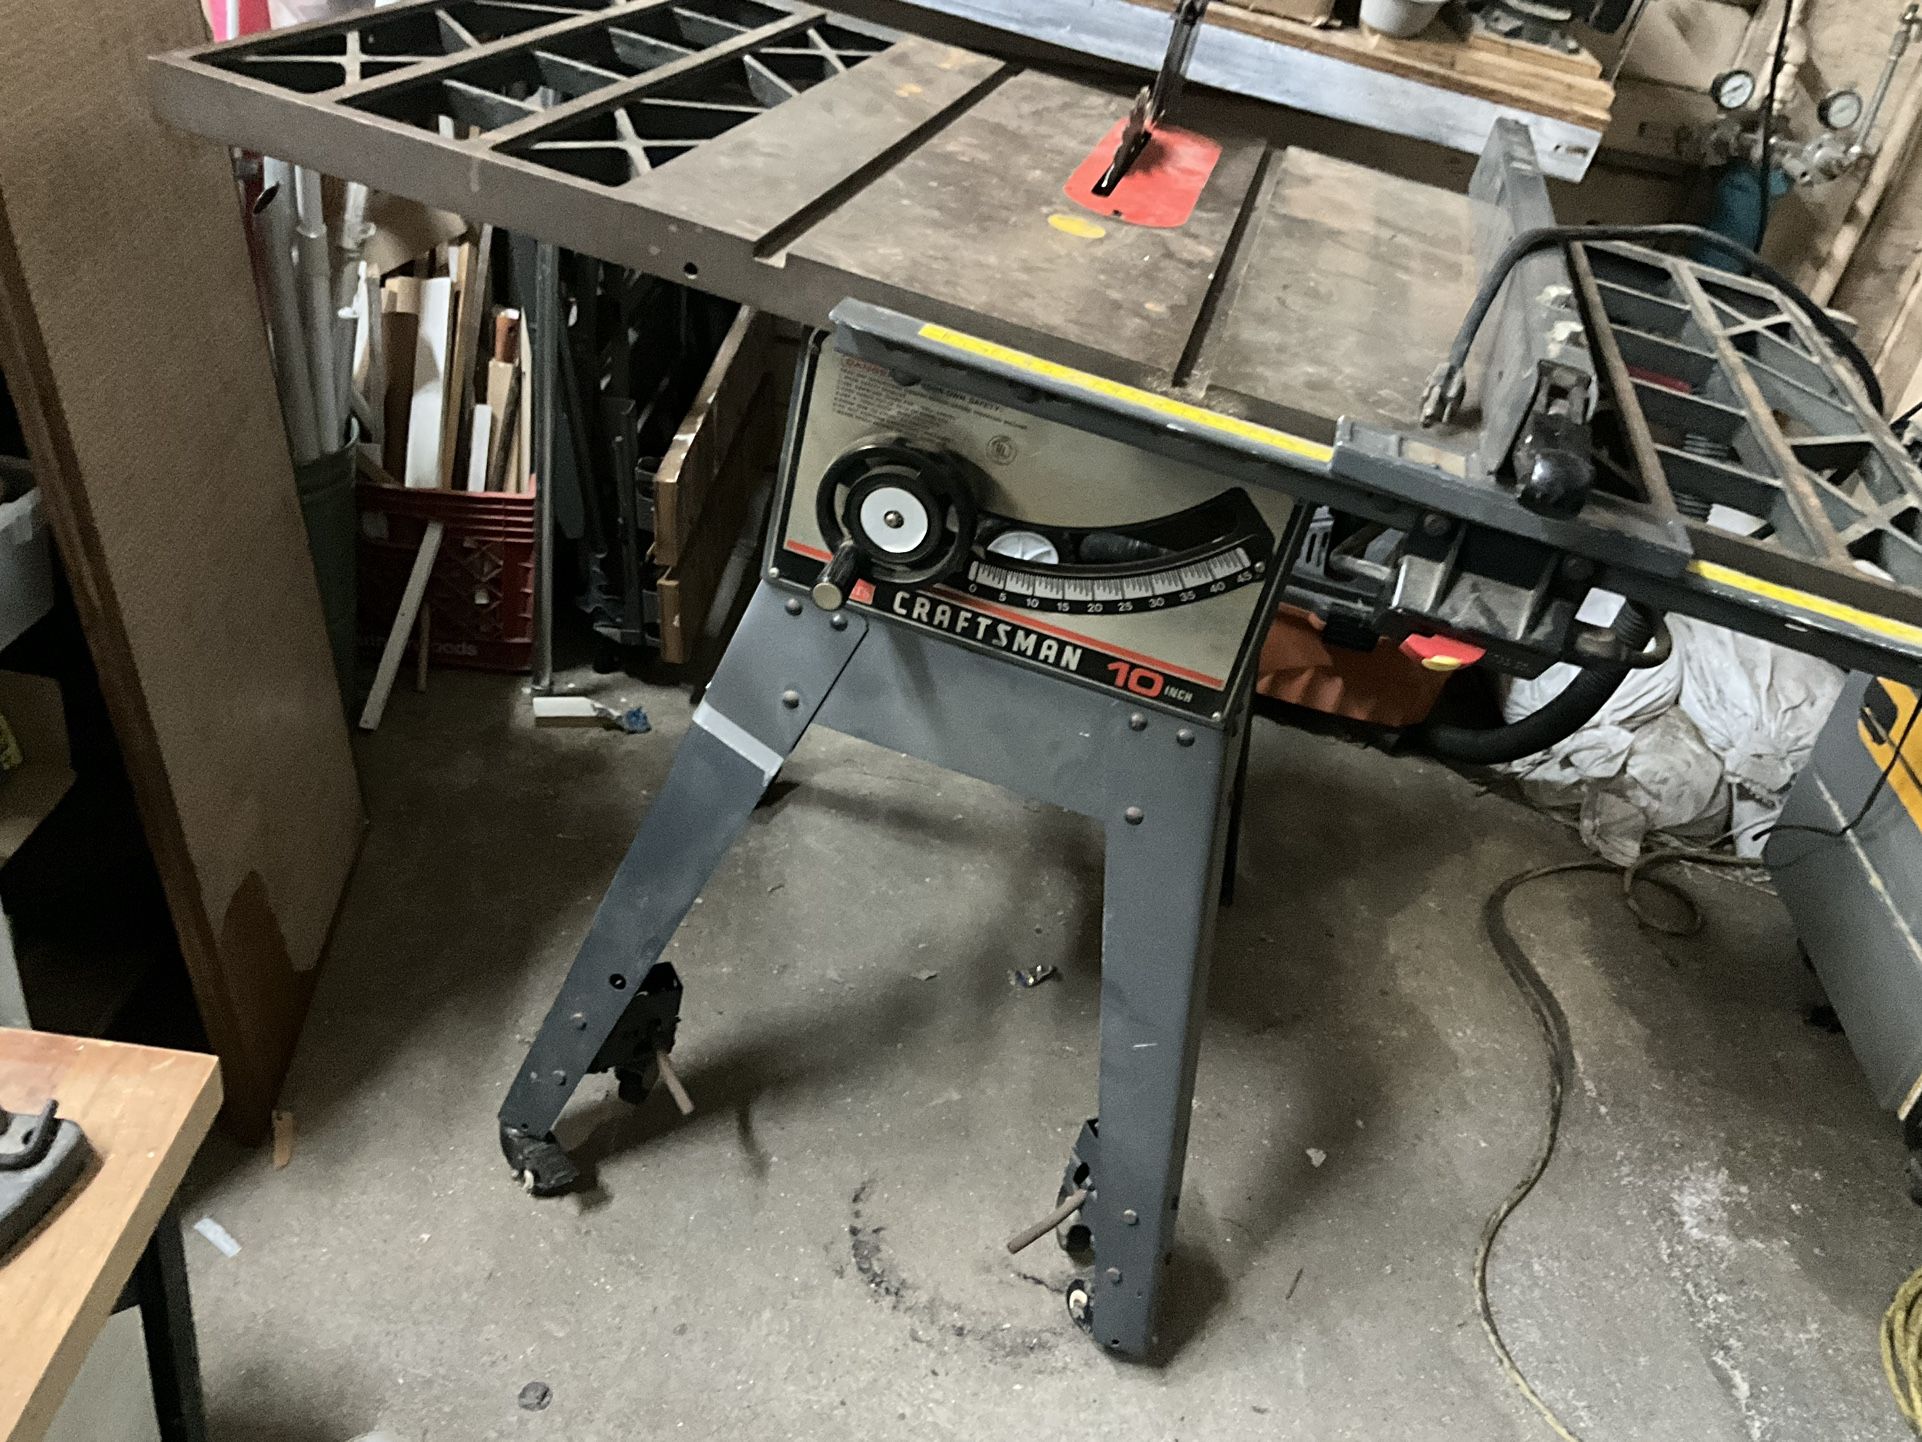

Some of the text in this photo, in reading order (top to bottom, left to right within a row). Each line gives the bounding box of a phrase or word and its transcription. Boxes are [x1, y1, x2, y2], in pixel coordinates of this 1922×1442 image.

[968, 571, 1252, 613] 0 5 10 15 20 25 30 35 40 45
[892, 591, 1083, 671] CRAFTSMAN
[1107, 661, 1164, 698] 10
[1164, 685, 1193, 703] INCH
